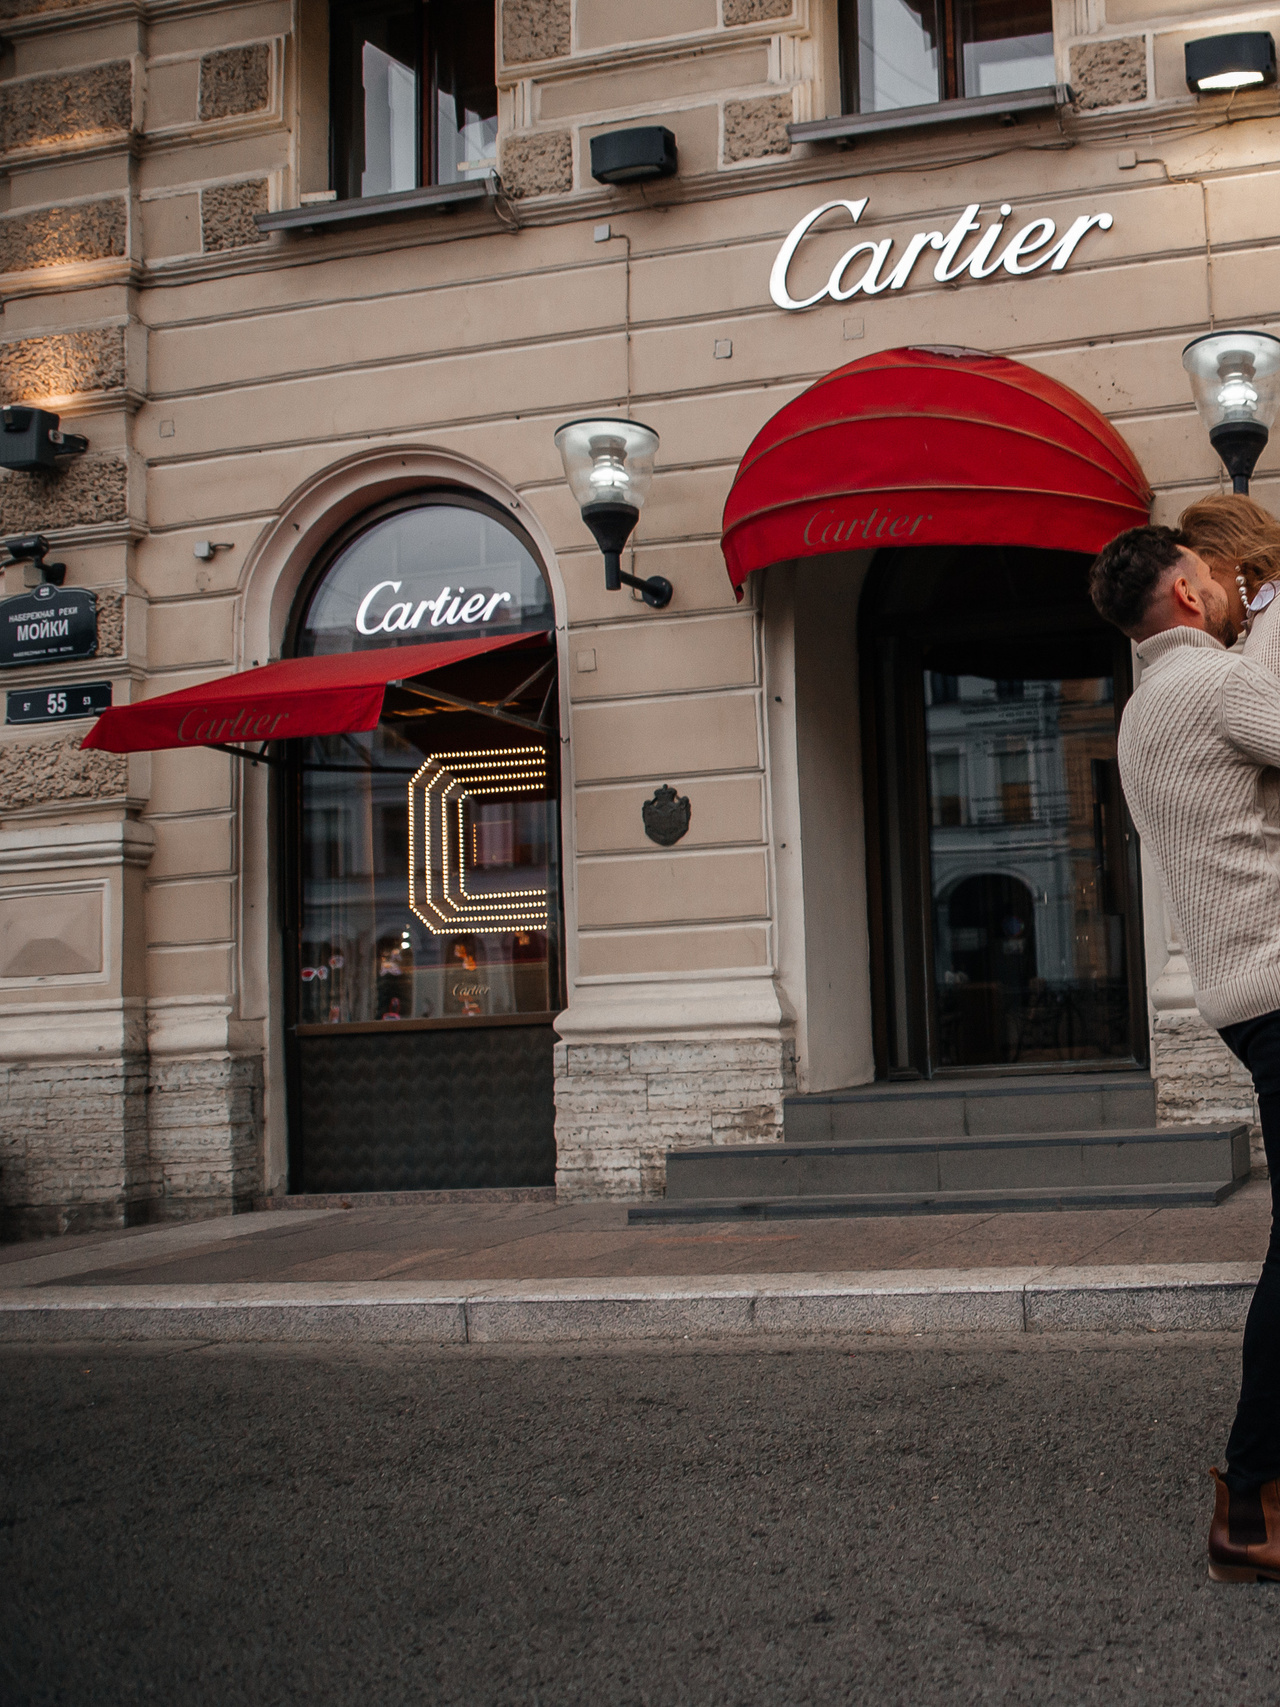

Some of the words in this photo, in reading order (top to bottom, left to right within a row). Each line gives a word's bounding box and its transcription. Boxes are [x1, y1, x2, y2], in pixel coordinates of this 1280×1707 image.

[769, 197, 1113, 311] Cartier
[803, 508, 933, 547] Cartier
[8, 609, 55, 623] НАБЕРЕЖНАЯ
[58, 606, 78, 616] РЕКИ
[355, 580, 511, 635] Cartier
[17, 618, 69, 641] МОЙКИ
[47, 692, 67, 714] 55
[83, 696, 91, 705] 53
[177, 706, 290, 743] Cartier
[452, 982, 491, 997] Cartier
